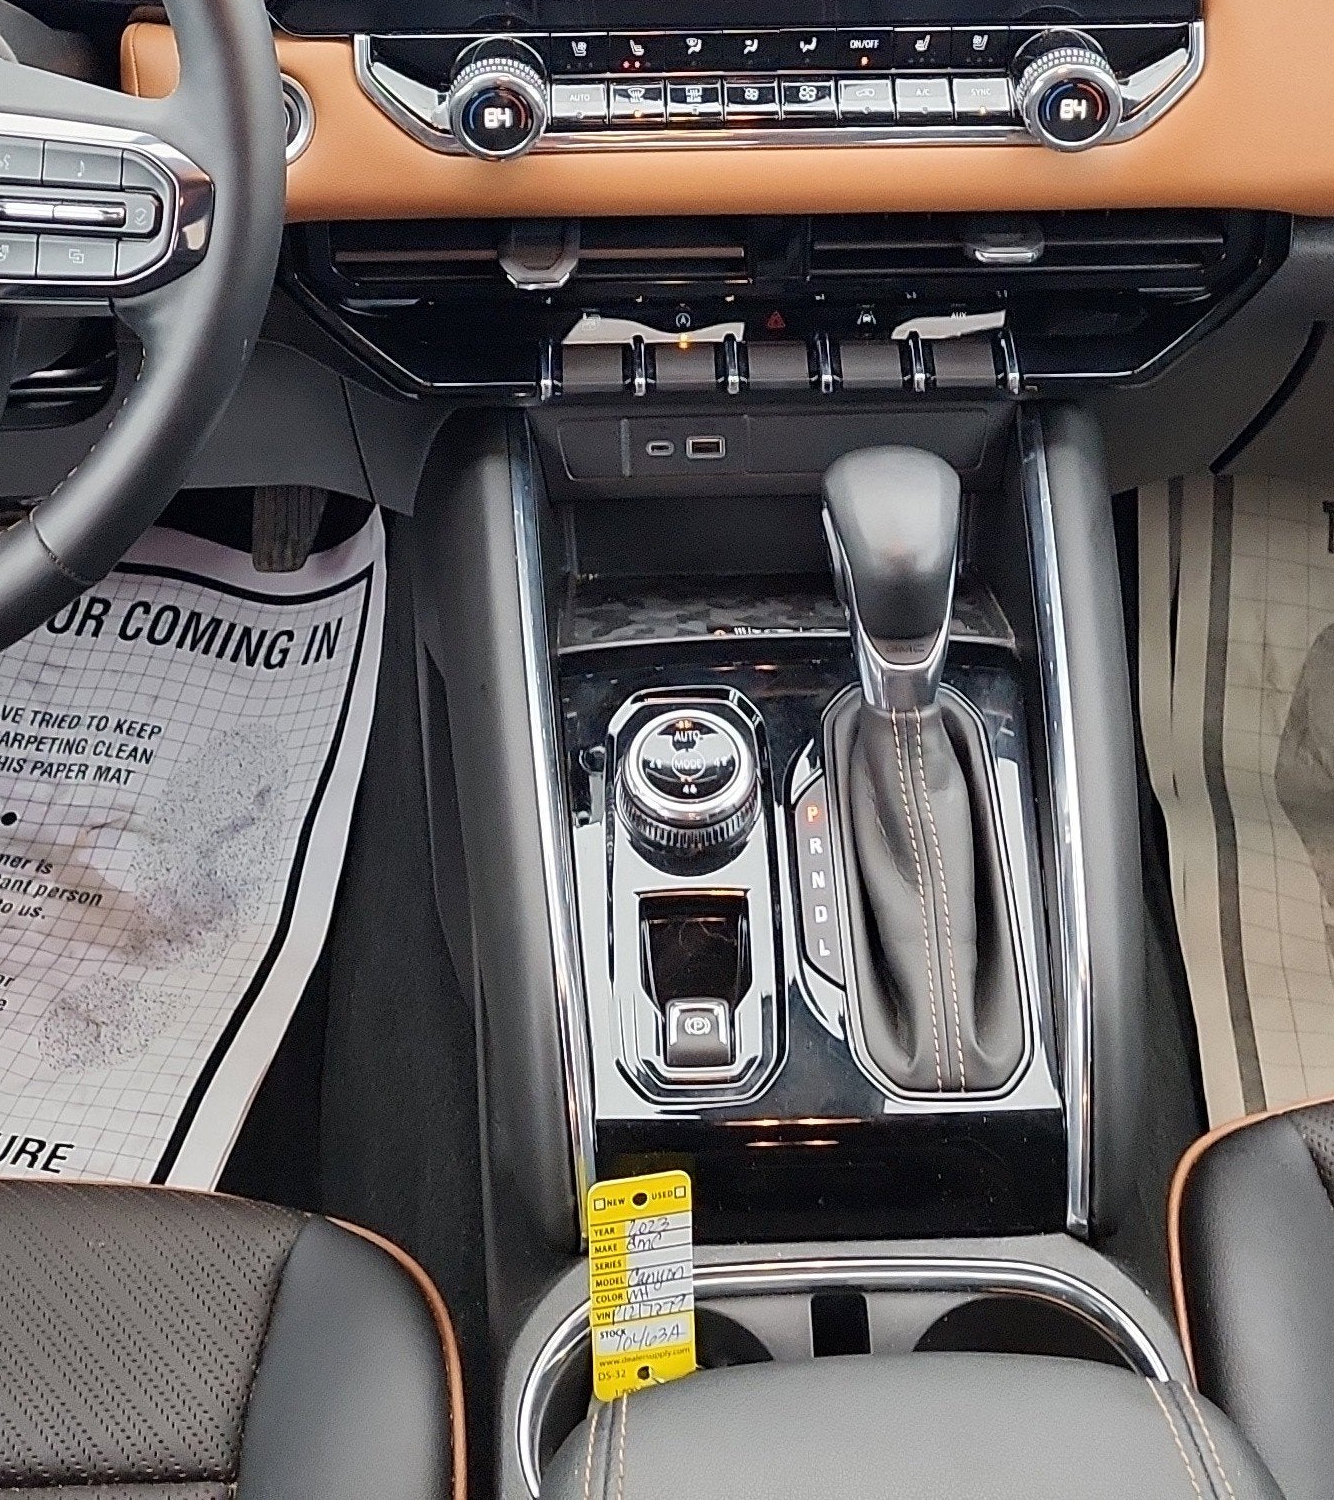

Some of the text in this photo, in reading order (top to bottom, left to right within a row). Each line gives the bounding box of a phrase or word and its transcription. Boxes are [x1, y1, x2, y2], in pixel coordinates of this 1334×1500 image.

[849, 39, 879, 50] ON/OFF
[916, 87, 930, 97] A/C
[970, 87, 991, 97] SYNC
[570, 94, 589, 102] AUTO
[1059, 99, 1085, 120] 84
[484, 108, 511, 128] 84
[950, 312, 967, 320] AUX
[47, 596, 342, 669] OR COMING IN
[30, 710, 81, 729] TRIED
[86, 715, 107, 732] TO
[114, 719, 161, 740] KEEP
[675, 731, 701, 742] AUTO
[92, 739, 153, 764] CLEAN
[675, 758, 702, 770] MODE
[30, 760, 86, 781] PAPER
[93, 766, 134, 786] MAT
[36, 860, 53, 875] is
[807, 806, 830, 956] P R N D L
[32, 883, 103, 907] person
[19, 904, 46, 919] us.
[652, 1190, 673, 1199] USED
[608, 1198, 625, 1206] NEW
[594, 1228, 615, 1236] YEAR
[595, 1243, 617, 1253] MAKE
[595, 1260, 622, 1270] SERIES
[595, 1278, 624, 1287] MODEL
[628, 1266, 683, 1291] Canyon
[596, 1293, 623, 1303] COLOR
[597, 1312, 610, 1320] VIN
[600, 1329, 626, 1339] STOCK
[599, 1347, 690, 1366] www.dealersupply.com
[599, 1370, 626, 1380] DS-32
